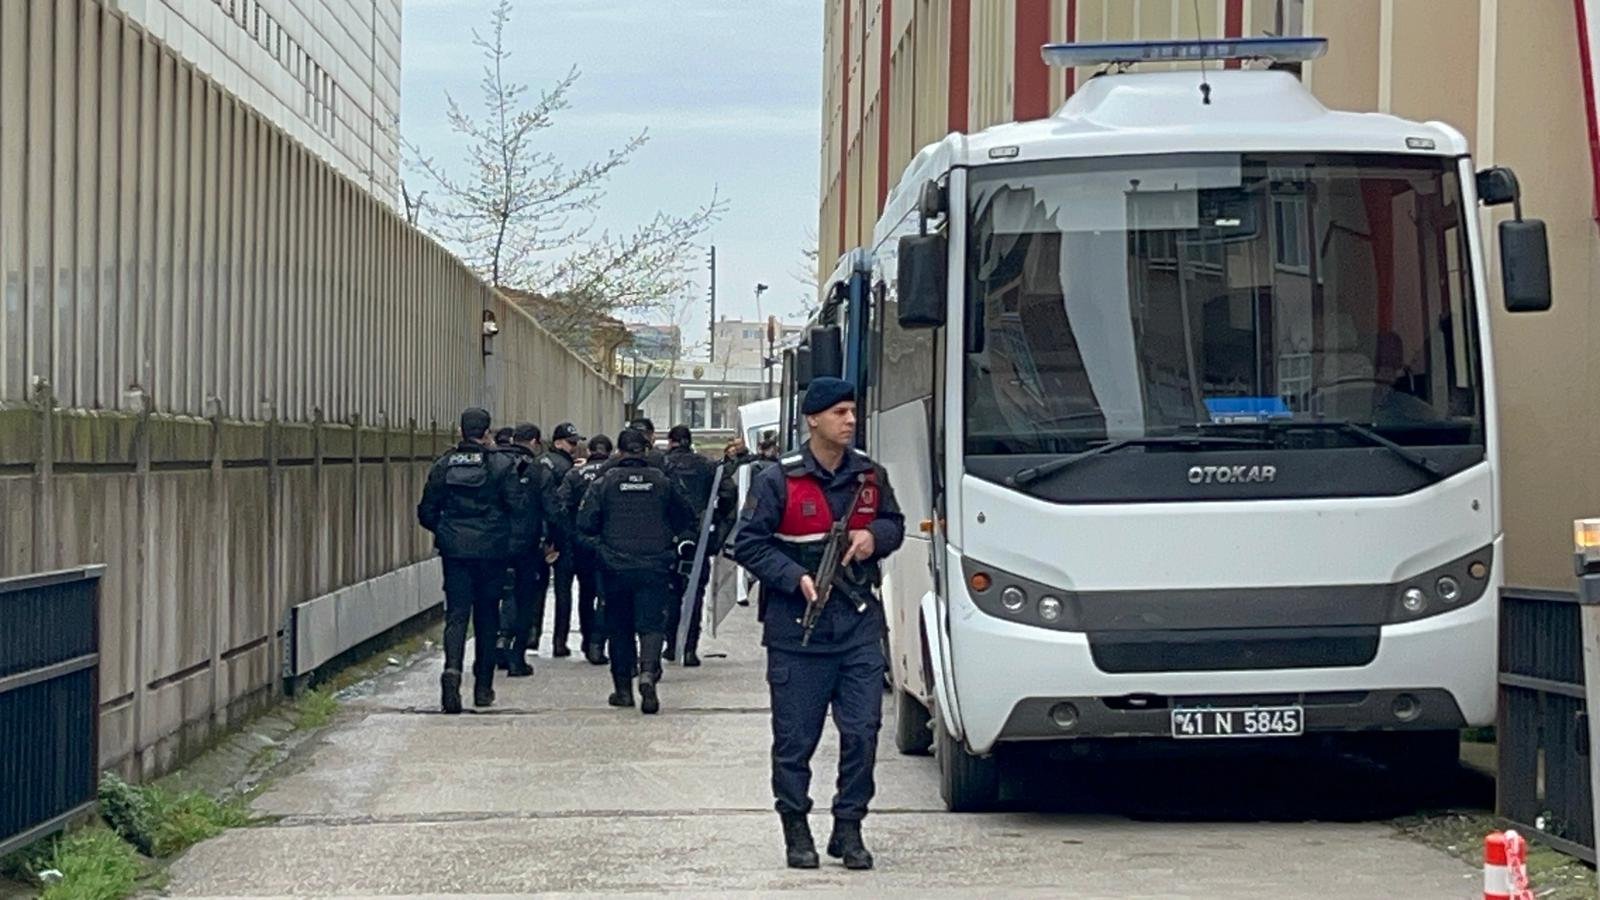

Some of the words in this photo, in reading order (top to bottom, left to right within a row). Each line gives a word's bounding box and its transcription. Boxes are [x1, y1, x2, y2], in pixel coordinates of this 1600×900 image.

[1188, 466, 1276, 483] OTOKAR
[1182, 713, 1203, 734] 41
[1215, 712, 1232, 733] N
[1244, 711, 1297, 732] 5845
